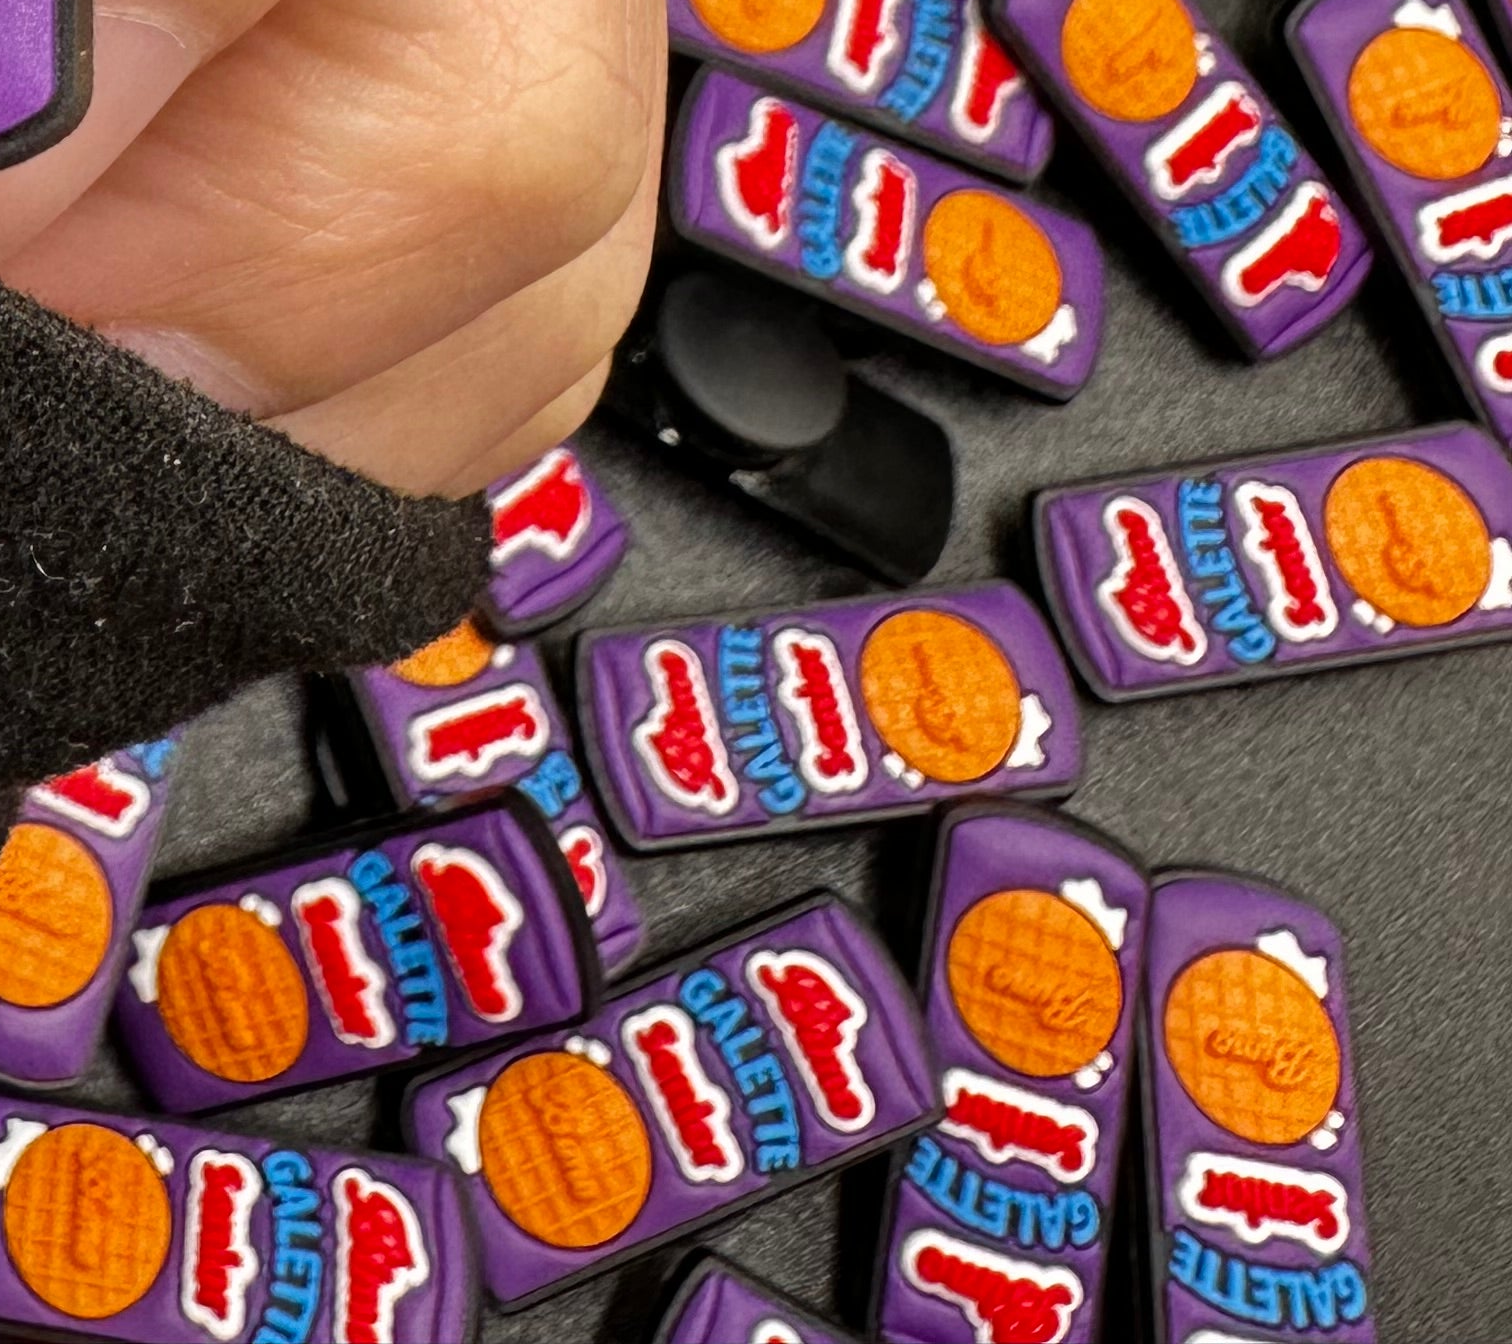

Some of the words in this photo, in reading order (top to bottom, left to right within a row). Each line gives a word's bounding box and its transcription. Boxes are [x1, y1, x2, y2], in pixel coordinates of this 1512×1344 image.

[1177, 479, 1275, 662] GALETTE
[719, 626, 805, 814] GALETTE
[348, 850, 450, 1047] GALETTE
[679, 968, 801, 1172] GALETTE
[905, 1137, 1100, 1248] GALETTE
[1168, 1229, 1367, 1328] GALETTE
